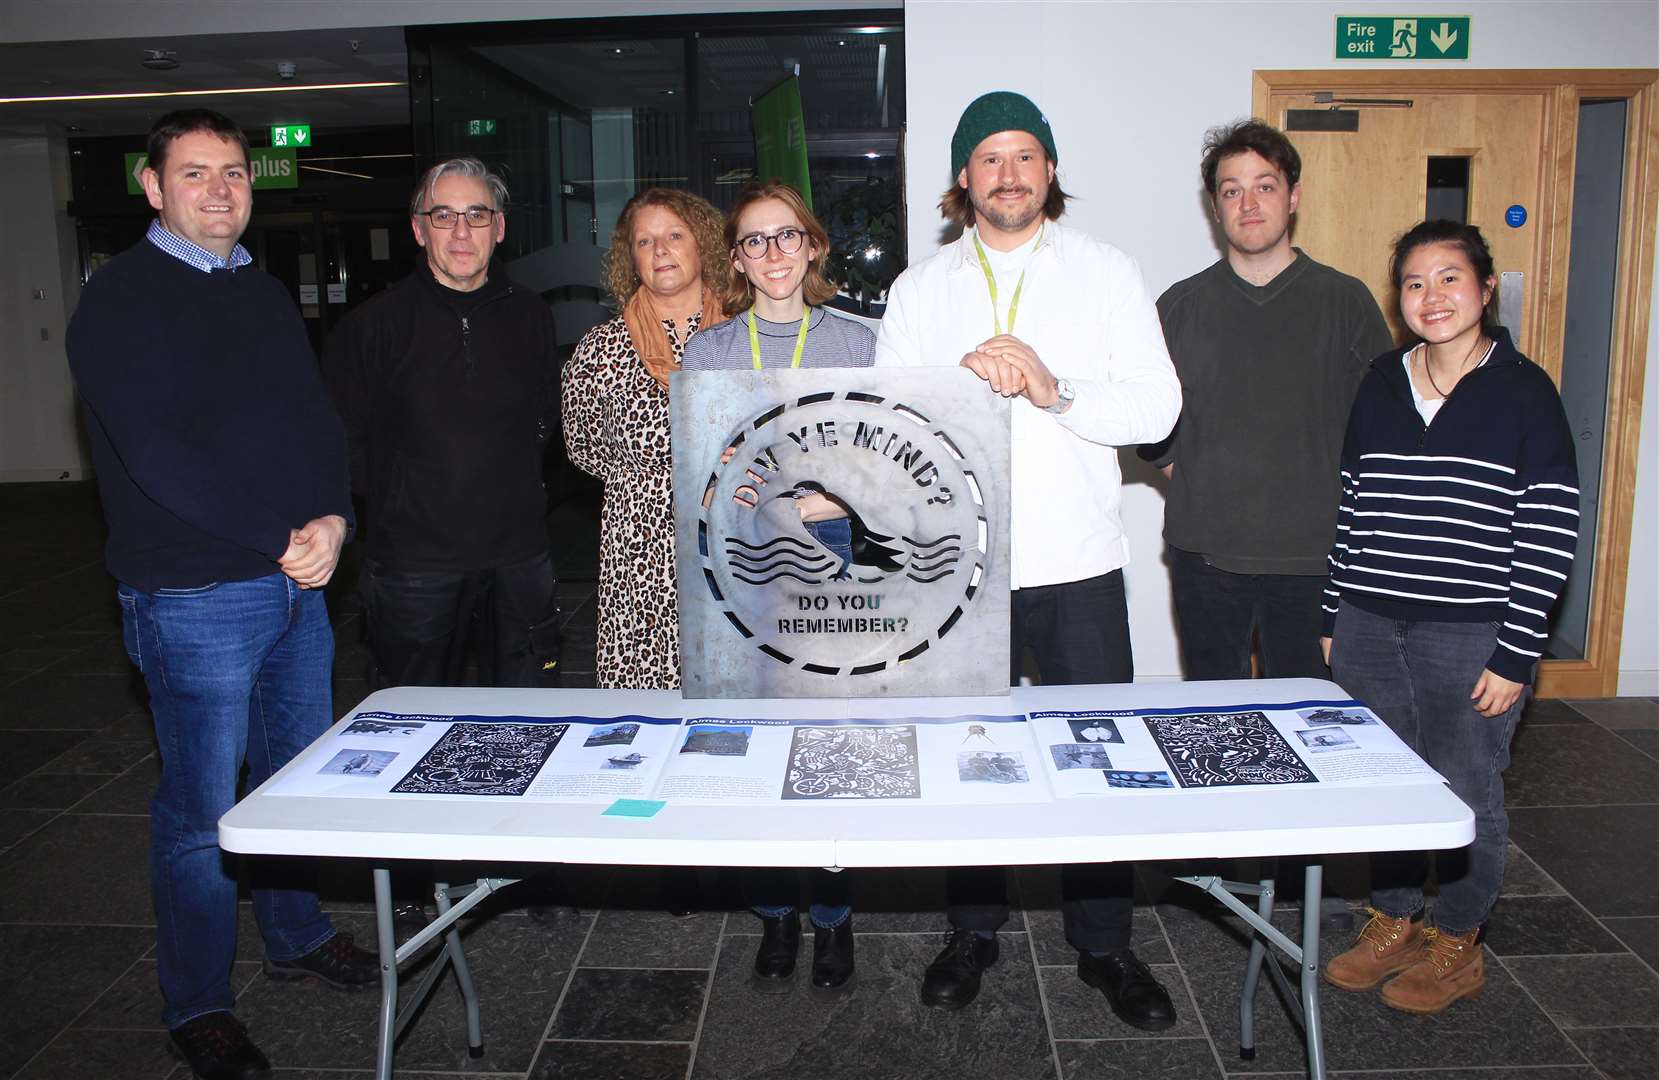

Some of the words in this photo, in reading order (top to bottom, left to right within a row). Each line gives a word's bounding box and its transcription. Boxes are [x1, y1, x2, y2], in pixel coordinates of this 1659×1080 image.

[1347, 23, 1376, 37] Fire
[1347, 40, 1375, 53] exit
[250, 155, 290, 185] plus
[732, 447, 780, 508] DIV
[786, 421, 838, 452] YE
[853, 421, 952, 505] MIND?
[798, 595, 829, 611] DO
[837, 594, 881, 610] YOU
[778, 617, 909, 634] REMEMBER?
